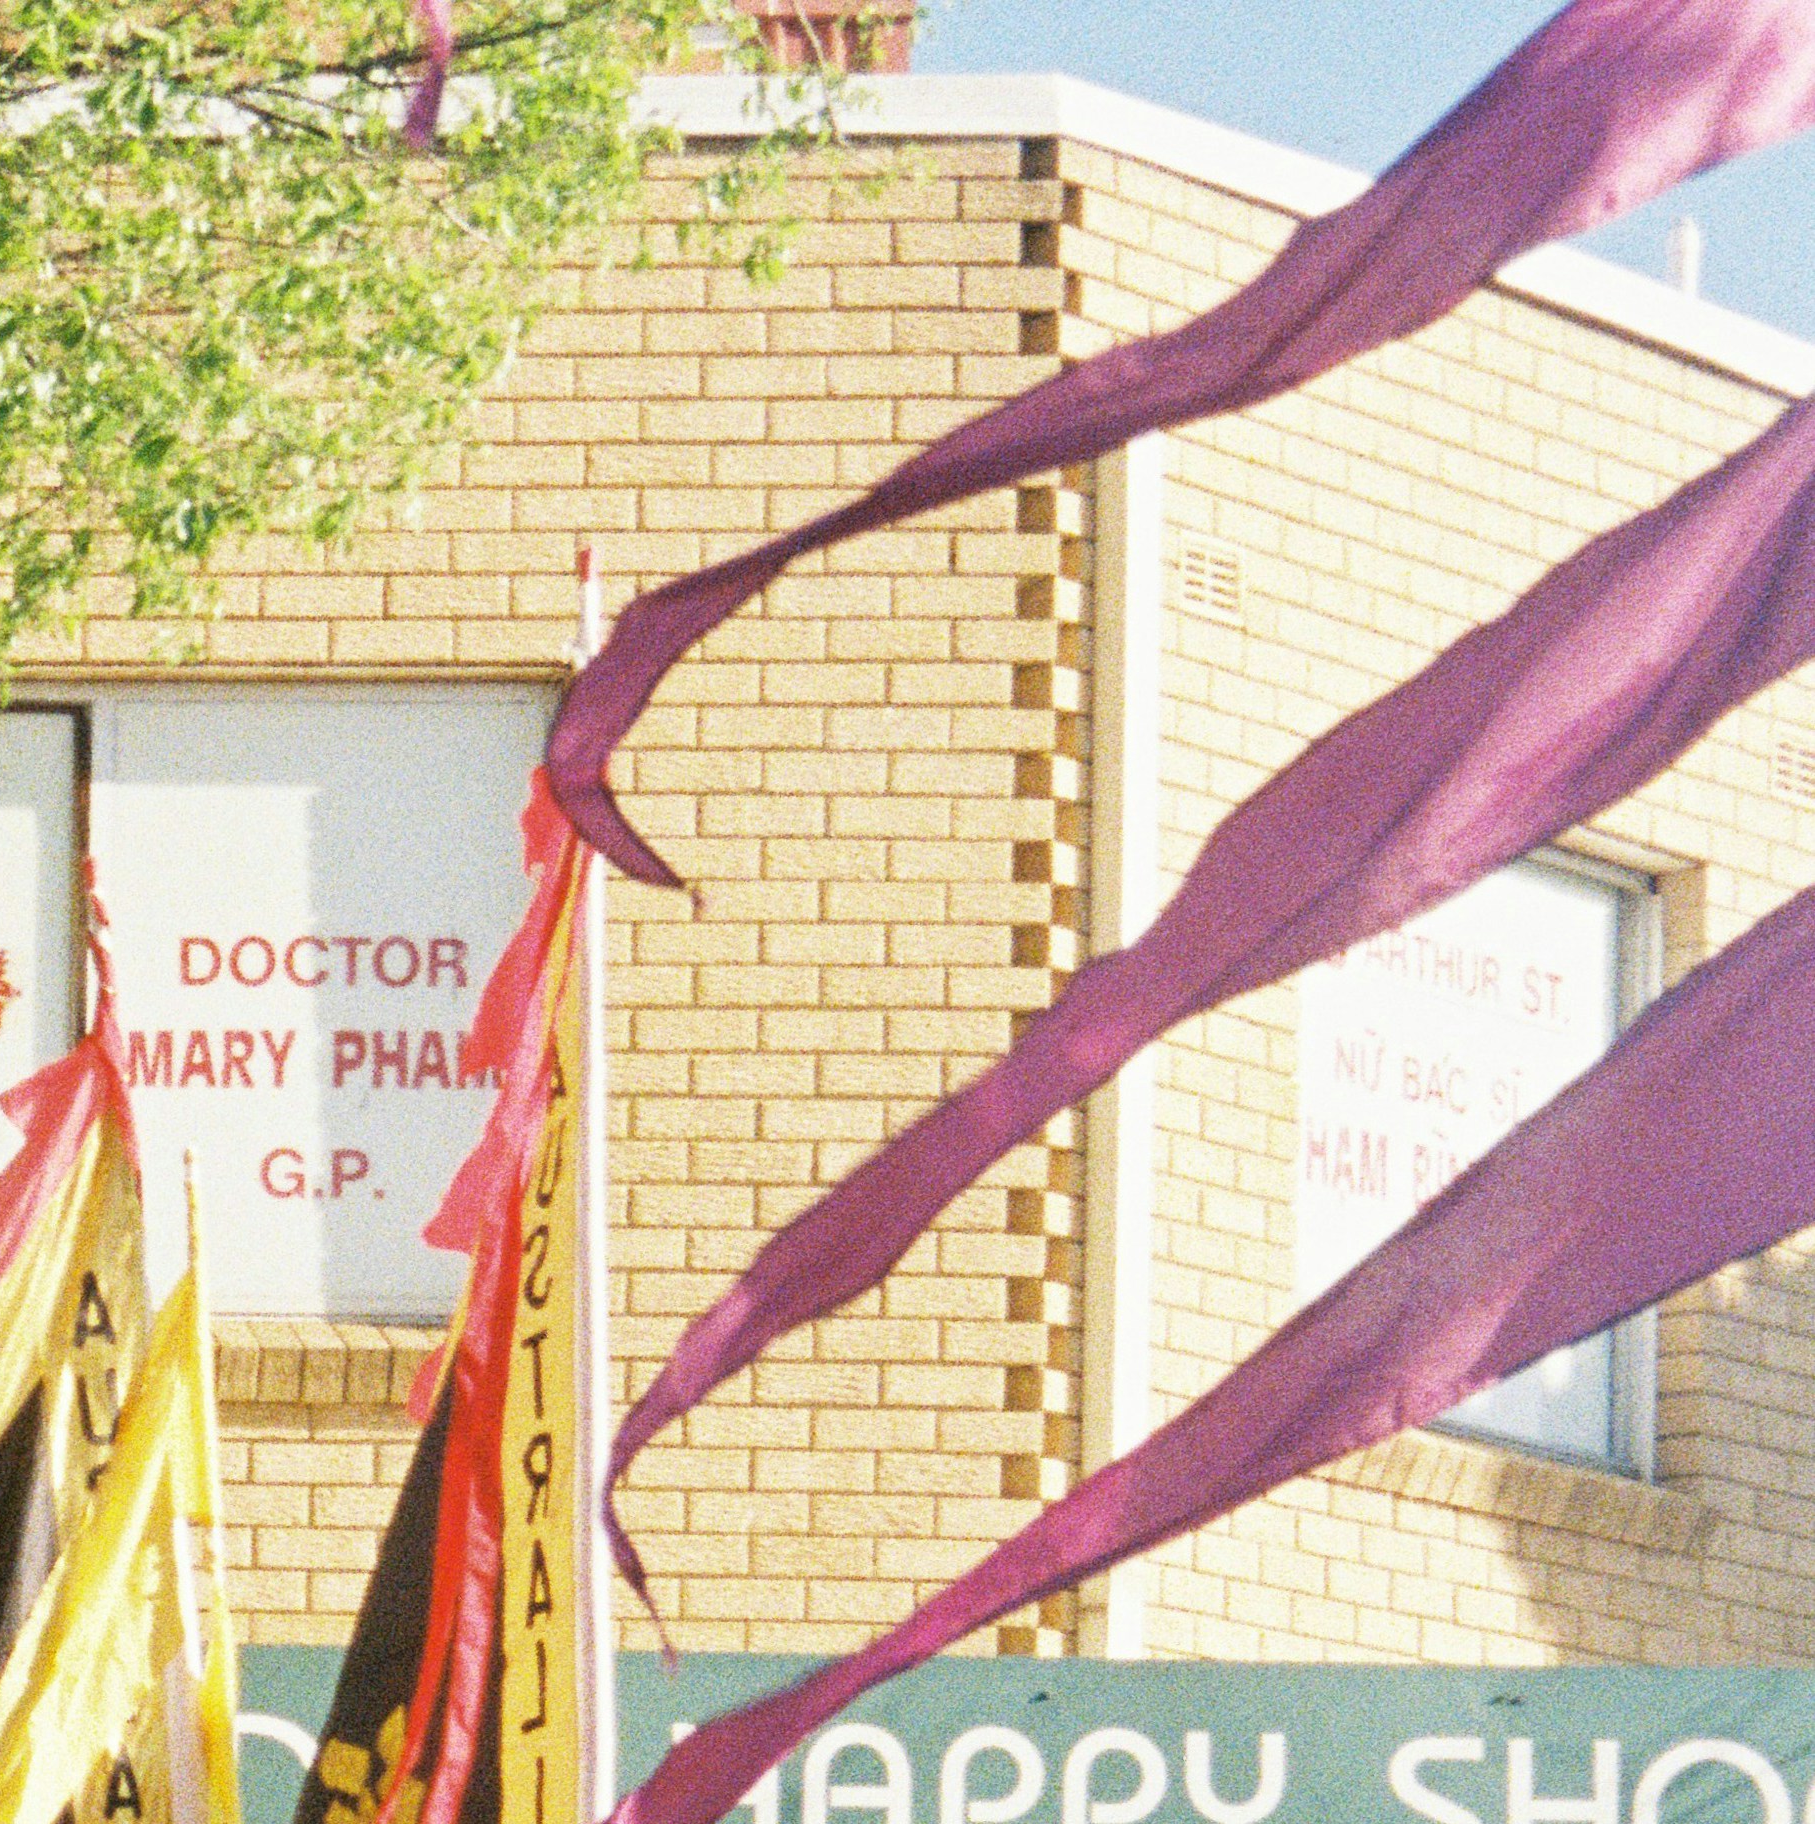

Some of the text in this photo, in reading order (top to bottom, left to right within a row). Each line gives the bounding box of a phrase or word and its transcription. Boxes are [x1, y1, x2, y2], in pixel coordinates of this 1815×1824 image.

[179, 936, 468, 988] DOCTOR
[128, 1030, 296, 1089] MARY
[260, 1148, 385, 1200] G.P.
